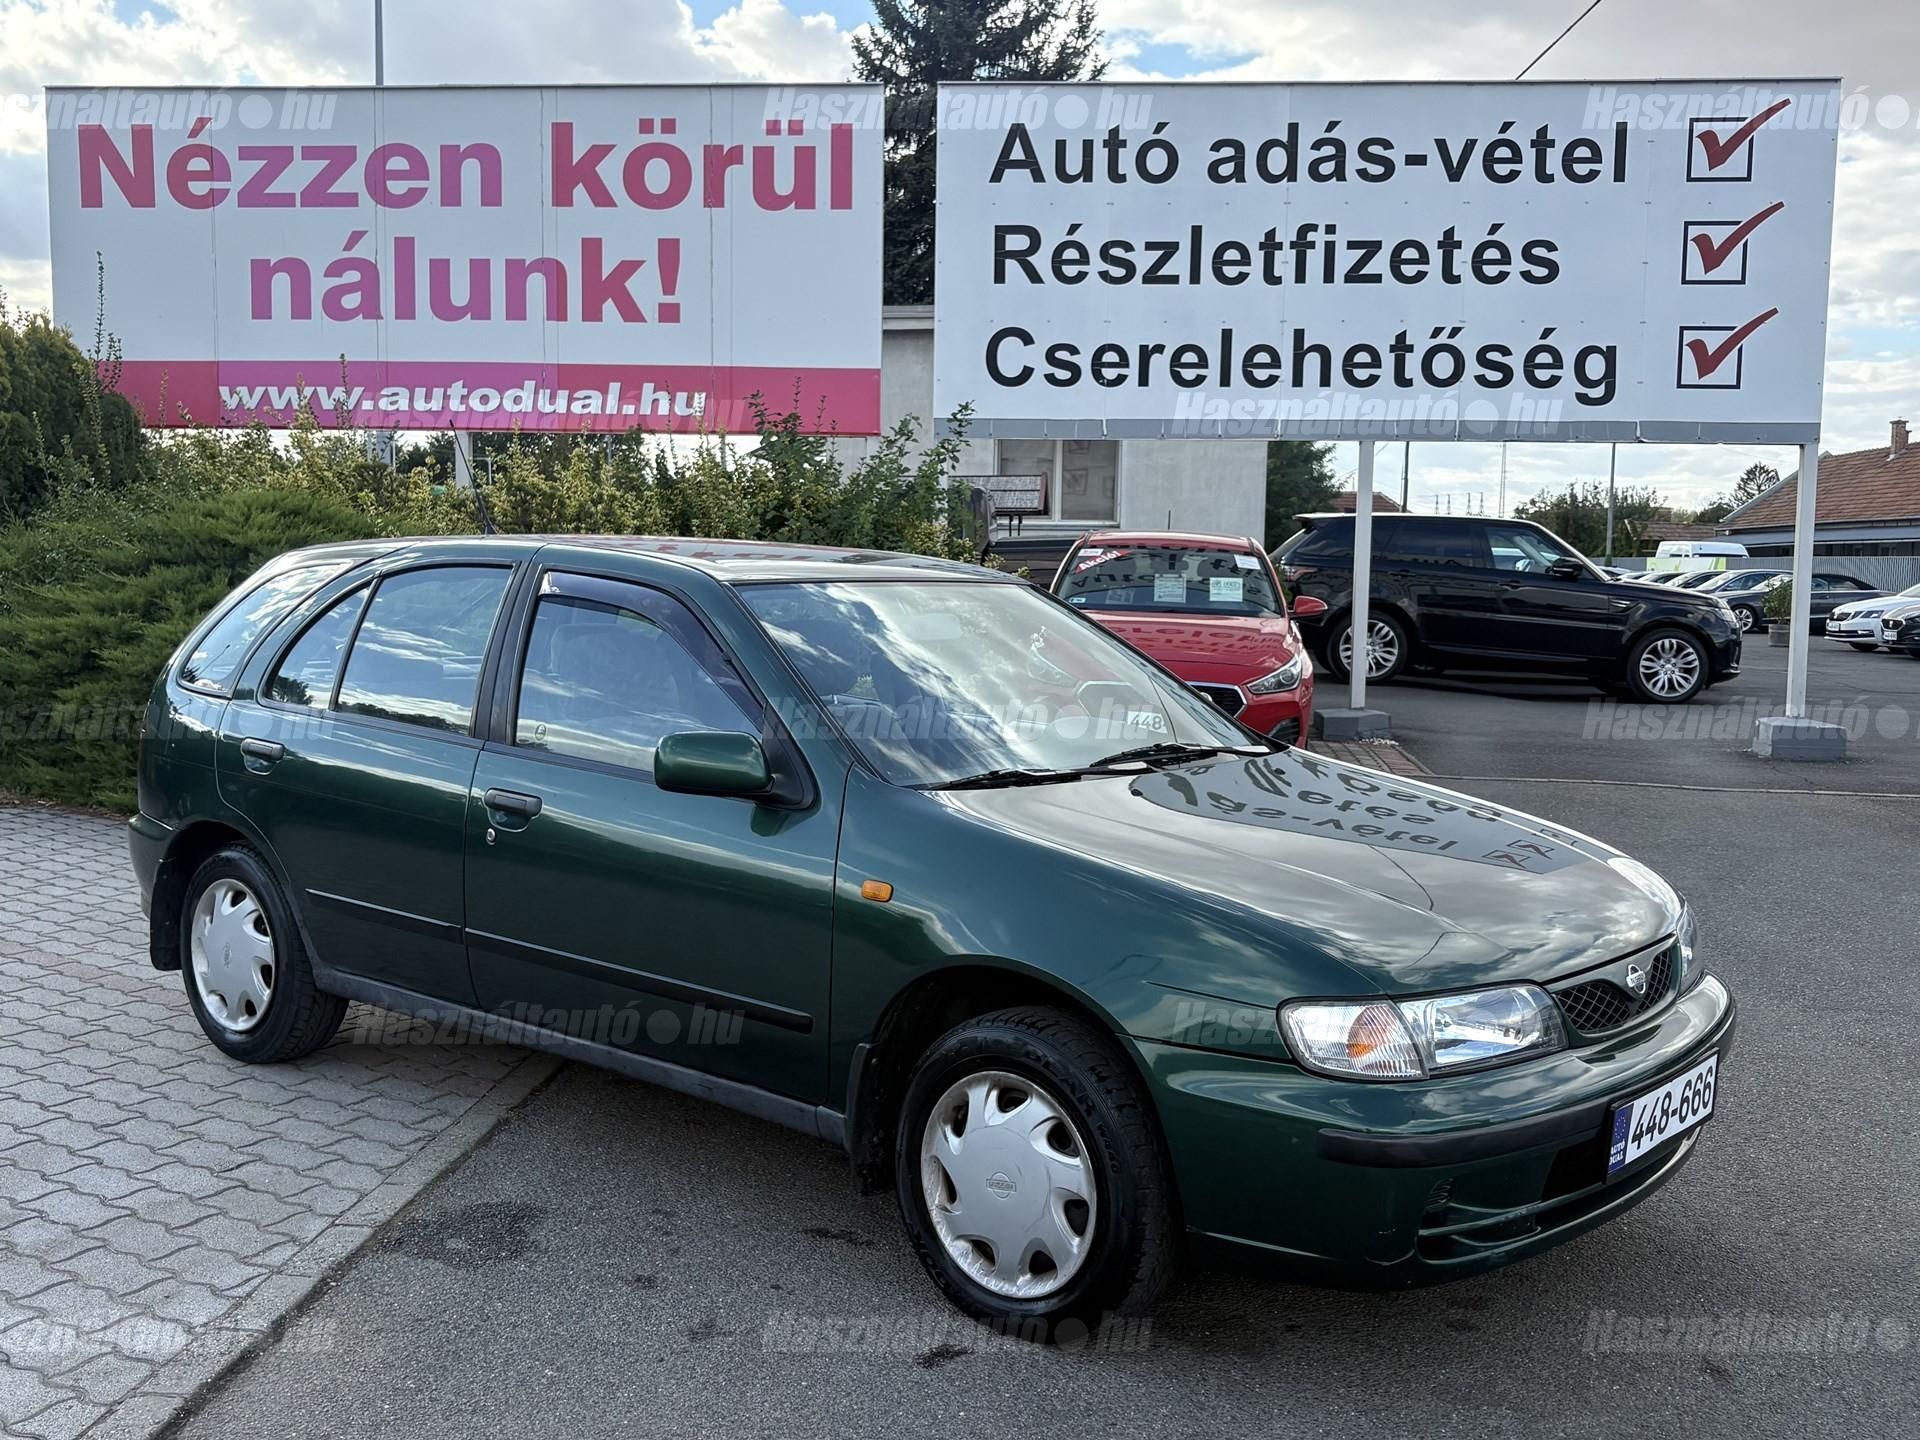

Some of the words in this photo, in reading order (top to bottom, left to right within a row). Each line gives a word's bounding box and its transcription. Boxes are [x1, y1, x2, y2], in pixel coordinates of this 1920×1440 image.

[80, 117, 501, 209] Nézzen
[553, 118, 852, 210] körül
[989, 121, 1179, 184] Autó
[1206, 119, 1628, 184] adás-vétel
[251, 230, 681, 324] nálunk!
[993, 222, 1561, 287] Részletfizetés
[218, 379, 706, 418] www.autodual.hu
[984, 325, 1618, 407] Cserelehetőség
[1631, 1065, 1713, 1150] 448-666
